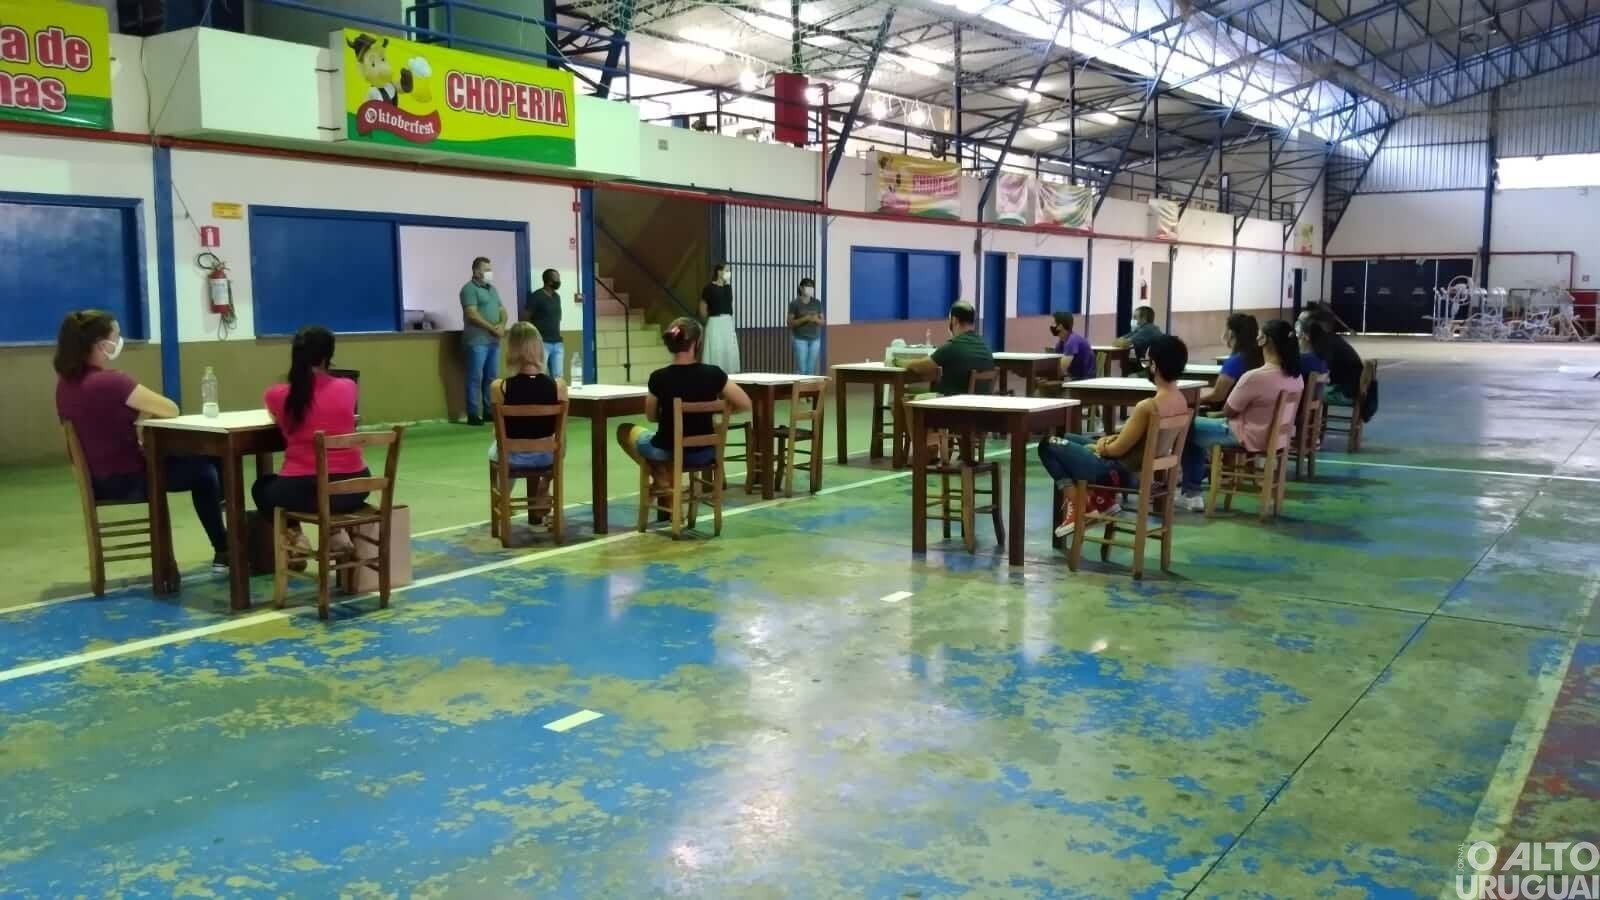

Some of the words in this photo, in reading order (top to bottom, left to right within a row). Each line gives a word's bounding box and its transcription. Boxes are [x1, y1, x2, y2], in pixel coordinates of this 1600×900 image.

[36, 26, 91, 71] de
[446, 70, 569, 126] CHOPERIA
[364, 107, 435, 135] Oktoberfest
